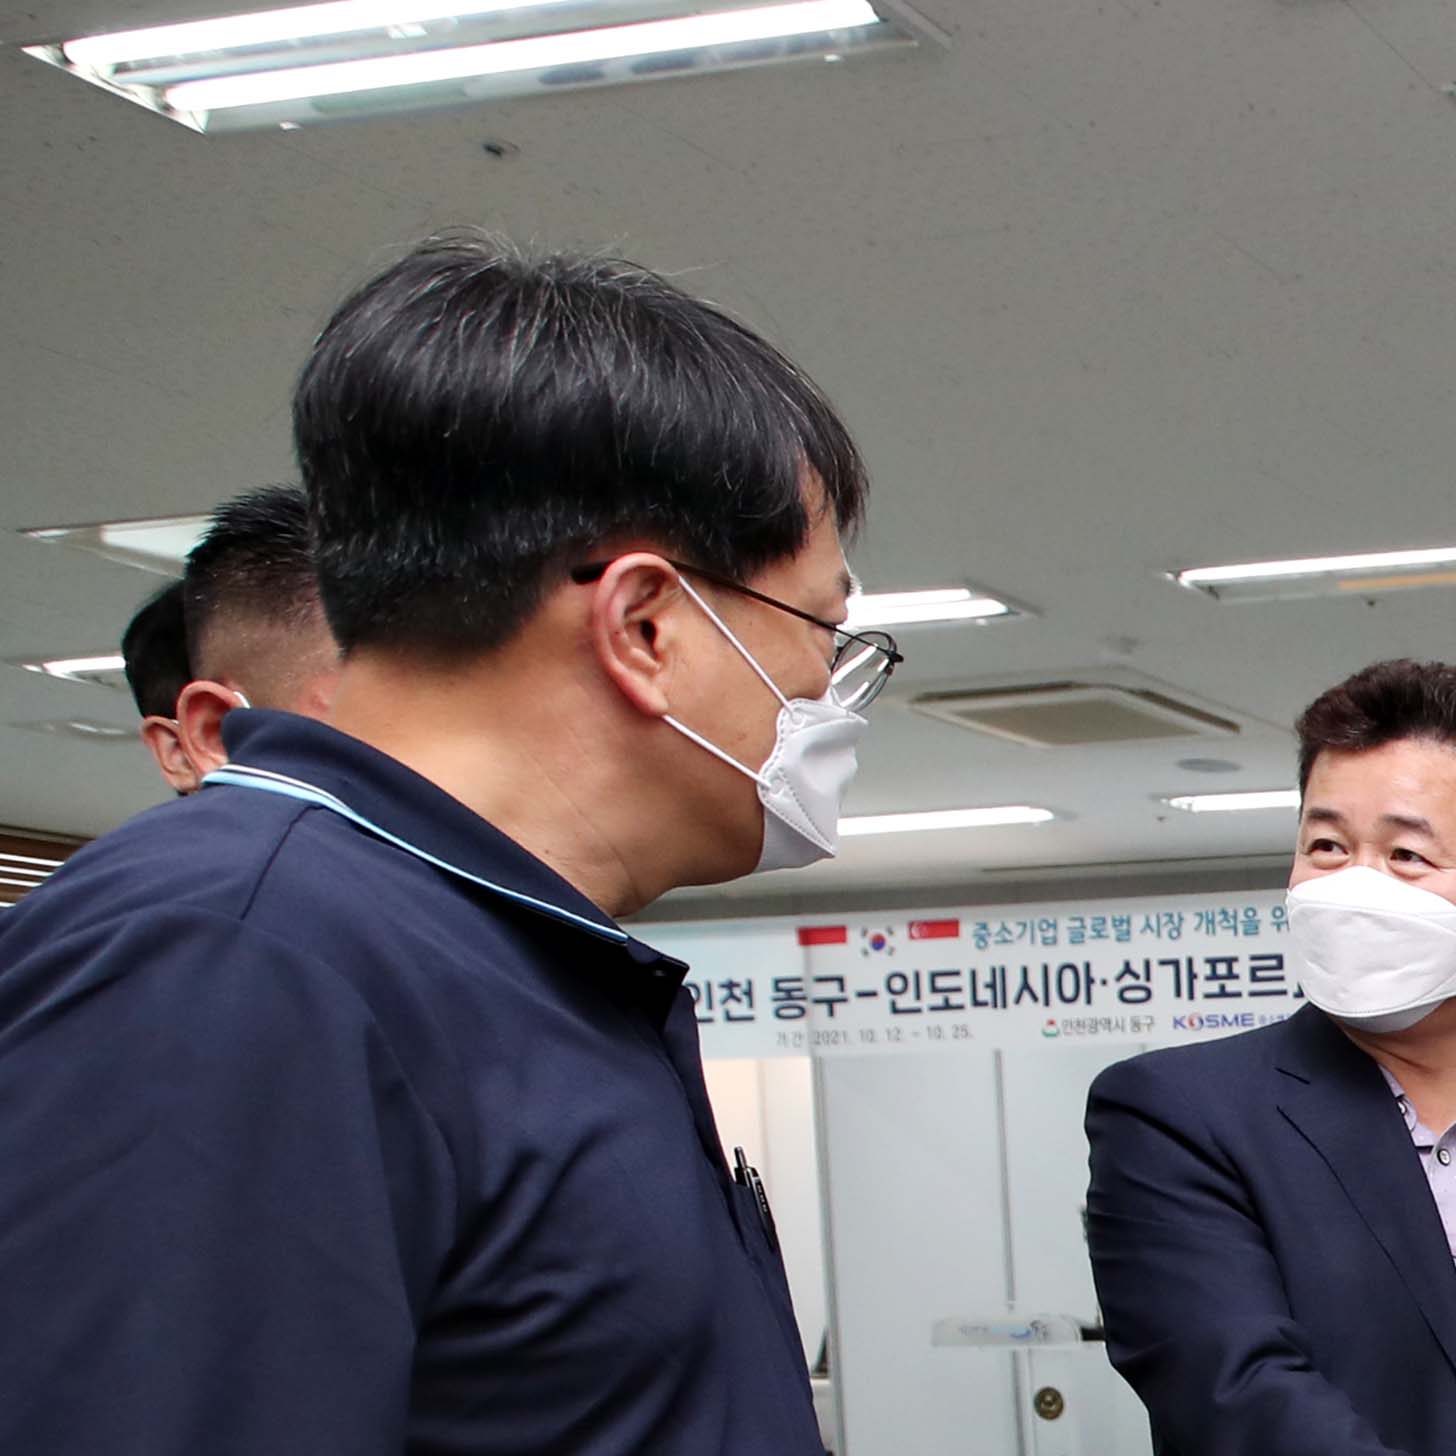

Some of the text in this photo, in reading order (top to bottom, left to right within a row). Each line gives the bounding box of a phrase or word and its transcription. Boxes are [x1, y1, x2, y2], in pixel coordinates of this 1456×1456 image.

[972, 904, 1290, 950] 중소기업 글로벌 시장 개척을 위
[685, 978, 755, 1024] 인천
[1130, 1014, 1156, 1034] 동구
[1172, 1011, 1255, 1032] KOSME
